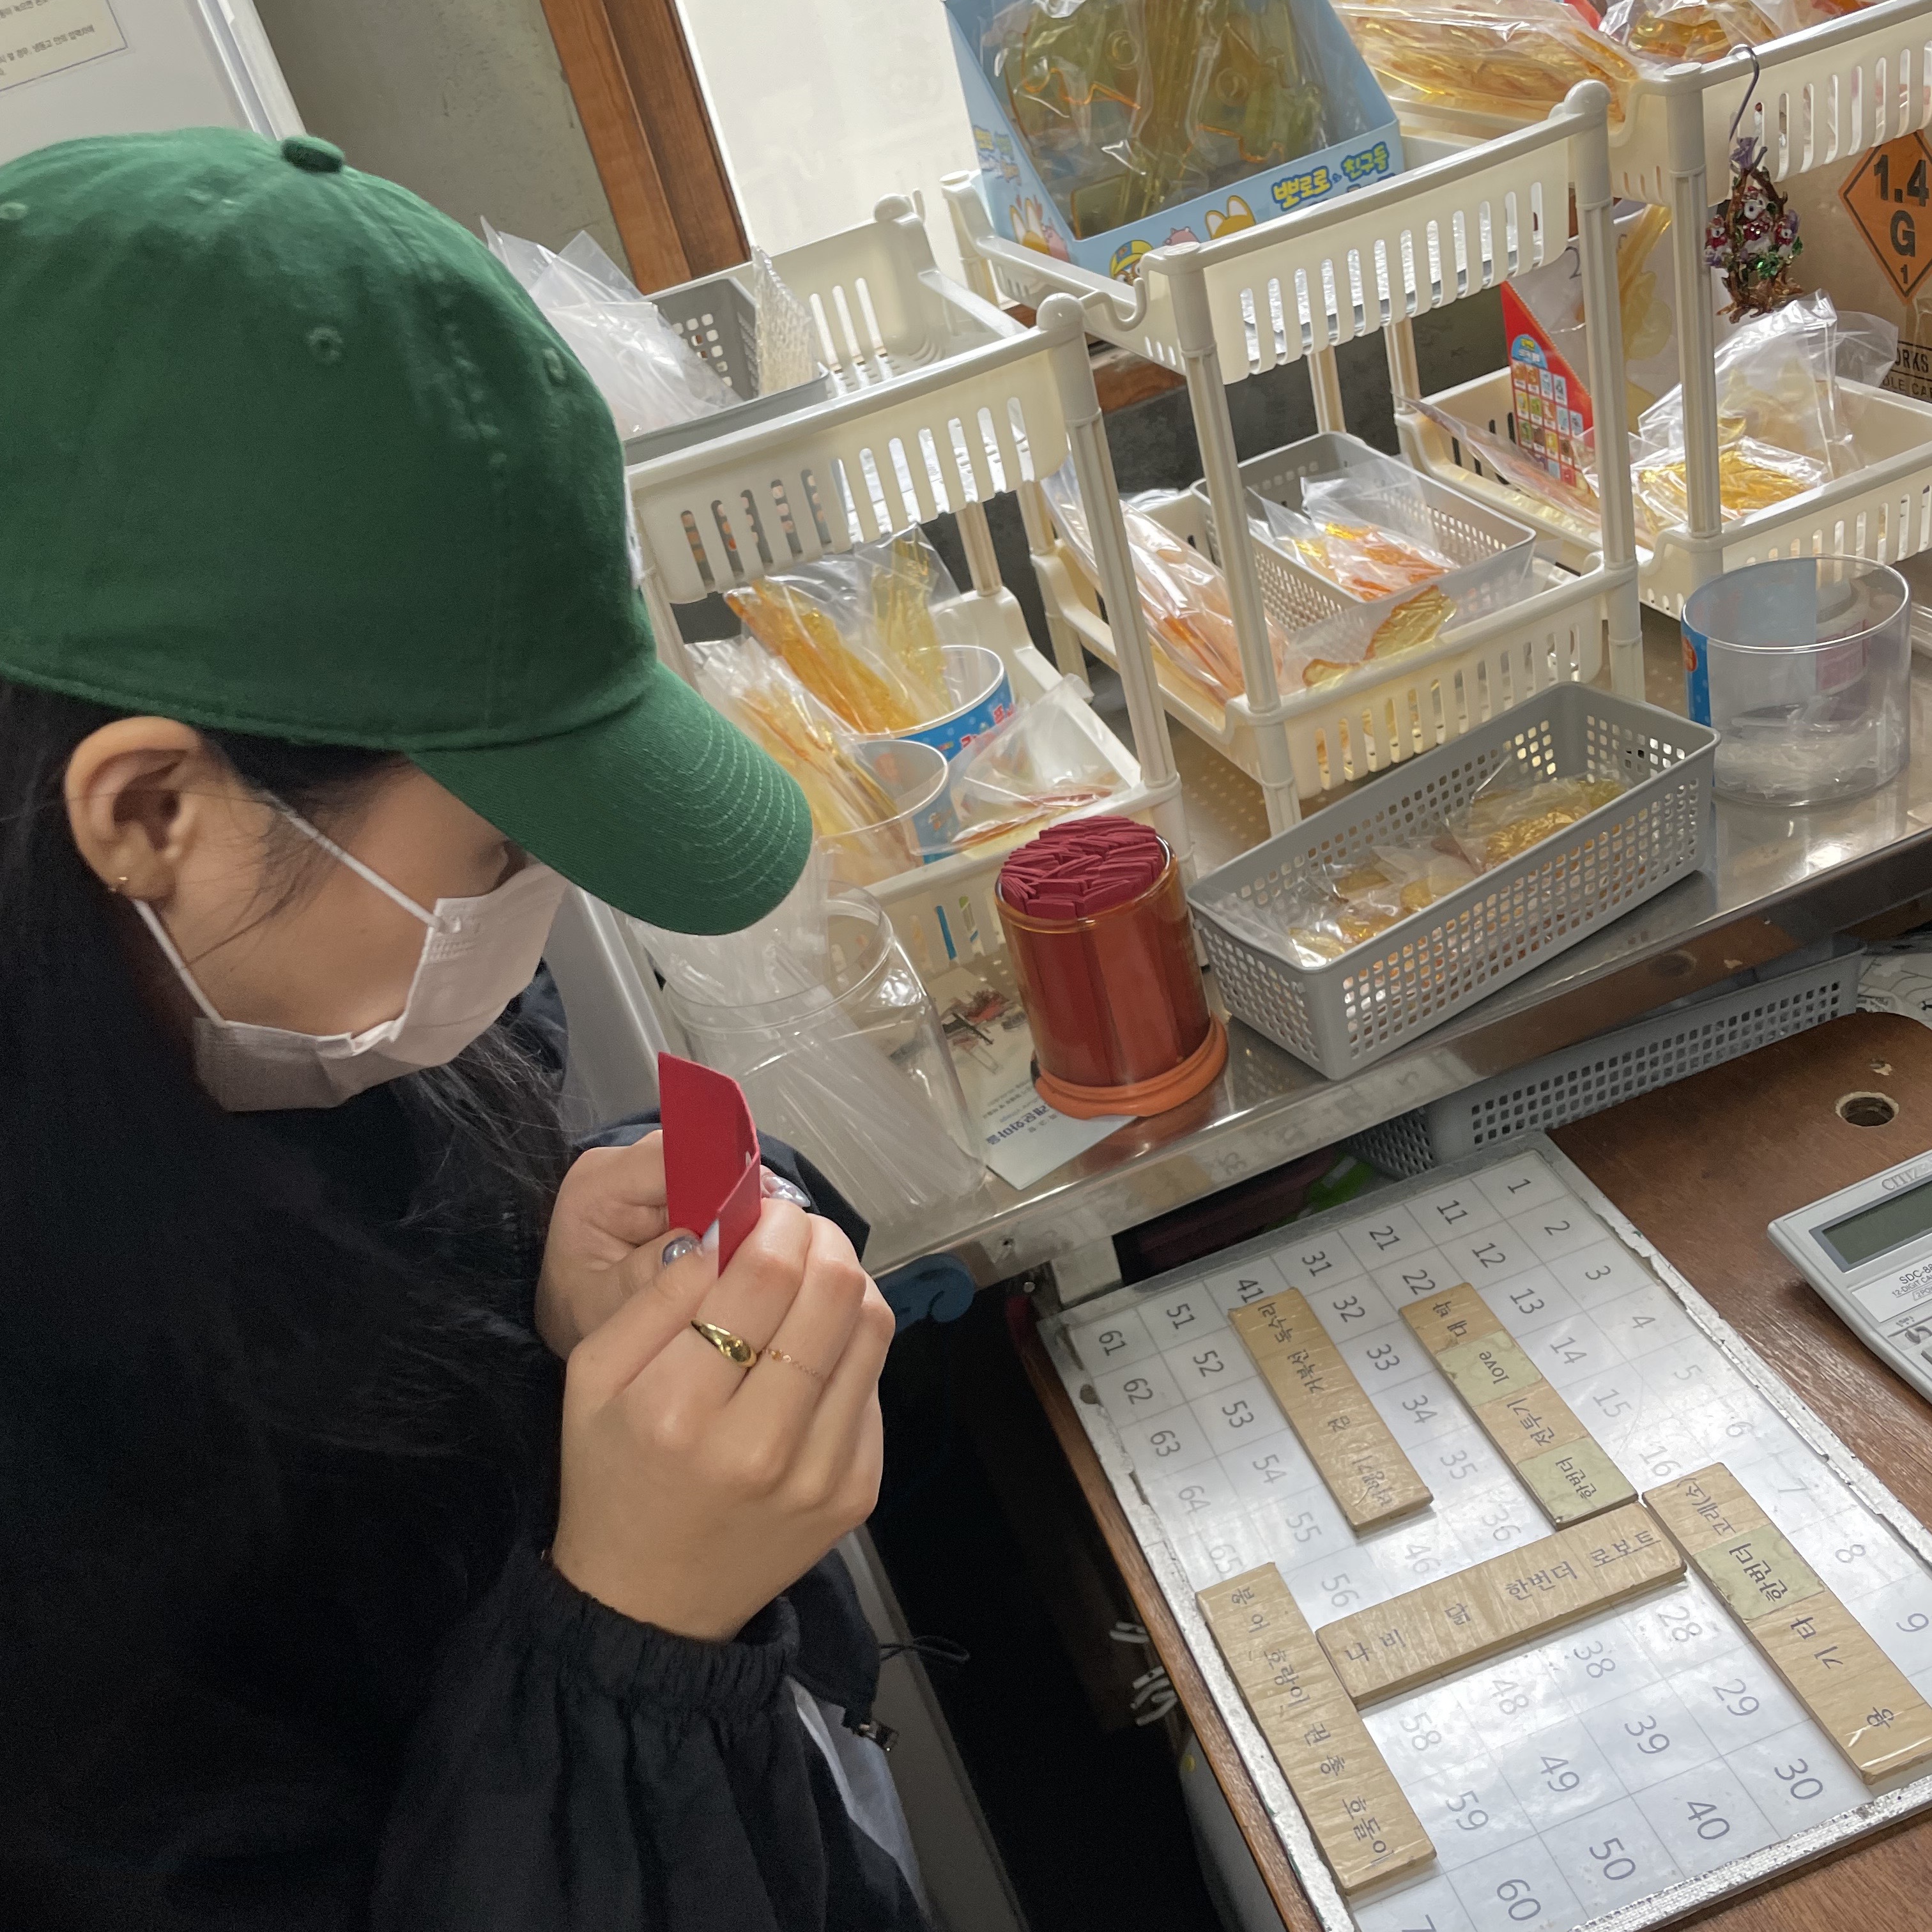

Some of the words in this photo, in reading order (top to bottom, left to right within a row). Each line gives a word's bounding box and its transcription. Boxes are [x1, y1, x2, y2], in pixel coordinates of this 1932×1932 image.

[1341, 141, 1390, 182] 친구들
[1874, 154, 1929, 207] 1.4
[1890, 210, 1916, 257] G
[1900, 264, 1908, 284] 1
[1506, 1177, 1531, 1193] 1
[1436, 1199, 1468, 1225] 11
[1369, 1225, 1399, 1251] 21
[1544, 1220, 1570, 1236] 2
[1301, 1250, 1332, 1277] 31
[1471, 1243, 1506, 1268] 12
[1402, 1269, 1436, 1296] 22
[1584, 1265, 1611, 1281] 3
[1236, 1278, 1264, 1303] 41
[1510, 1288, 1545, 1315] 13
[1166, 1303, 1196, 1330] 51
[1257, 1303, 1292, 1344] 독수리
[1332, 1295, 1365, 1322] 32
[1630, 1314, 1656, 1330] 4
[1098, 1330, 1126, 1357] 61
[1366, 1344, 1400, 1371] 33
[1549, 1337, 1587, 1365] 14
[1193, 1350, 1225, 1377] 52
[1286, 1349, 1324, 1394] 거북선
[1478, 1350, 1510, 1385] love
[1671, 1364, 1703, 1381] 5
[1123, 1379, 1153, 1404] 62
[1591, 1389, 1632, 1418] 15
[1222, 1400, 1255, 1427] 53
[1327, 1415, 1351, 1432] 검
[1402, 1395, 1438, 1423] 34
[1506, 1397, 1556, 1446] 전투기
[1149, 1430, 1181, 1456] 63
[1725, 1421, 1755, 1439] 6
[1252, 1453, 1287, 1483] 54
[1439, 1449, 1478, 1480] 35
[1638, 1446, 1682, 1476] 16
[1555, 1457, 1597, 1499] 한번더
[1777, 1478, 1811, 1492] 7
[1177, 1485, 1211, 1515] 64
[1676, 1477, 1736, 1537] 고래(소)
[1286, 1511, 1322, 1542] 55
[1480, 1508, 1521, 1542] 36
[1404, 1542, 1441, 1574] 46
[1590, 1530, 1661, 1568] 로보트
[1834, 1544, 1866, 1563] 8
[1505, 1561, 1576, 1600] 한번더
[1729, 1542, 1788, 1602] 한번더
[1321, 1572, 1359, 1606] 56
[1444, 1602, 1471, 1626] 닭
[1659, 1606, 1703, 1642] 28
[1896, 1613, 1929, 1632] 9
[1574, 1641, 1616, 1678] 38
[1263, 1650, 1312, 1708] 호랑이
[1491, 1678, 1529, 1715] 48
[1712, 1679, 1759, 1717] 29
[1399, 1713, 1441, 1750] 58
[1866, 1706, 1895, 1729] 용
[1624, 1715, 1670, 1754] 39
[1540, 1756, 1581, 1793] 49
[1774, 1758, 1823, 1800] 30
[1446, 1791, 1488, 1830] 59
[1687, 1801, 1730, 1840] 40
[1342, 1797, 1395, 1866] 호돌이
[1589, 1837, 1636, 1880] 50
[1496, 1878, 1542, 1920] 60
